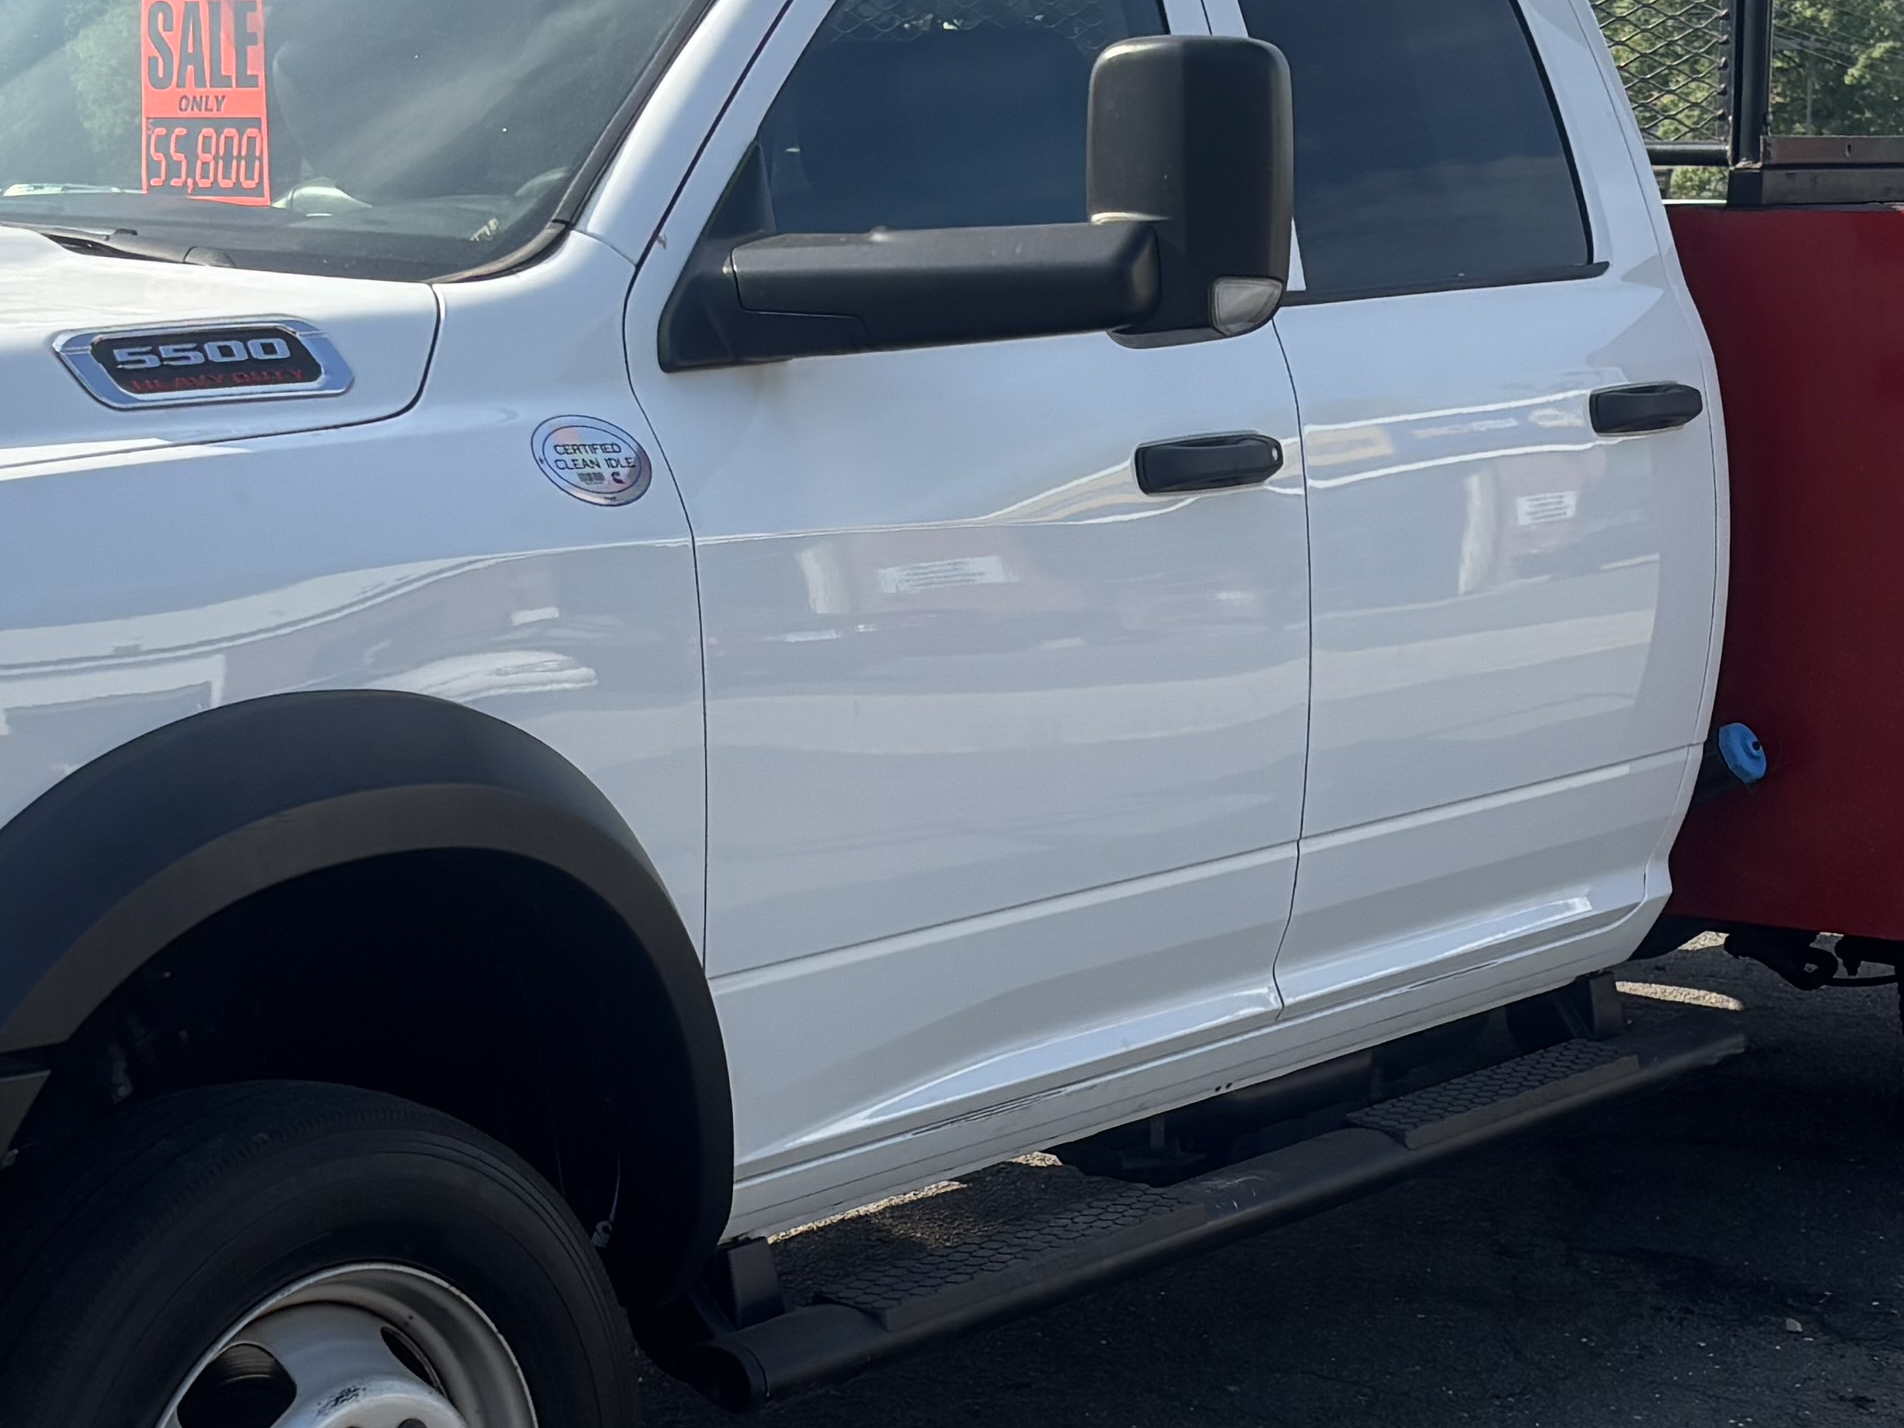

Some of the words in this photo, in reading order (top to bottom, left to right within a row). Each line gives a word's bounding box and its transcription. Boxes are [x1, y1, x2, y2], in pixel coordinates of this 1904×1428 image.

[147, 0, 260, 90] SALE
[179, 95, 226, 112] ONLY
[112, 338, 291, 369] 5500
[553, 443, 622, 455] CERTIFIED
[554, 457, 600, 470] CLEAN
[606, 456, 636, 469] IDLE
